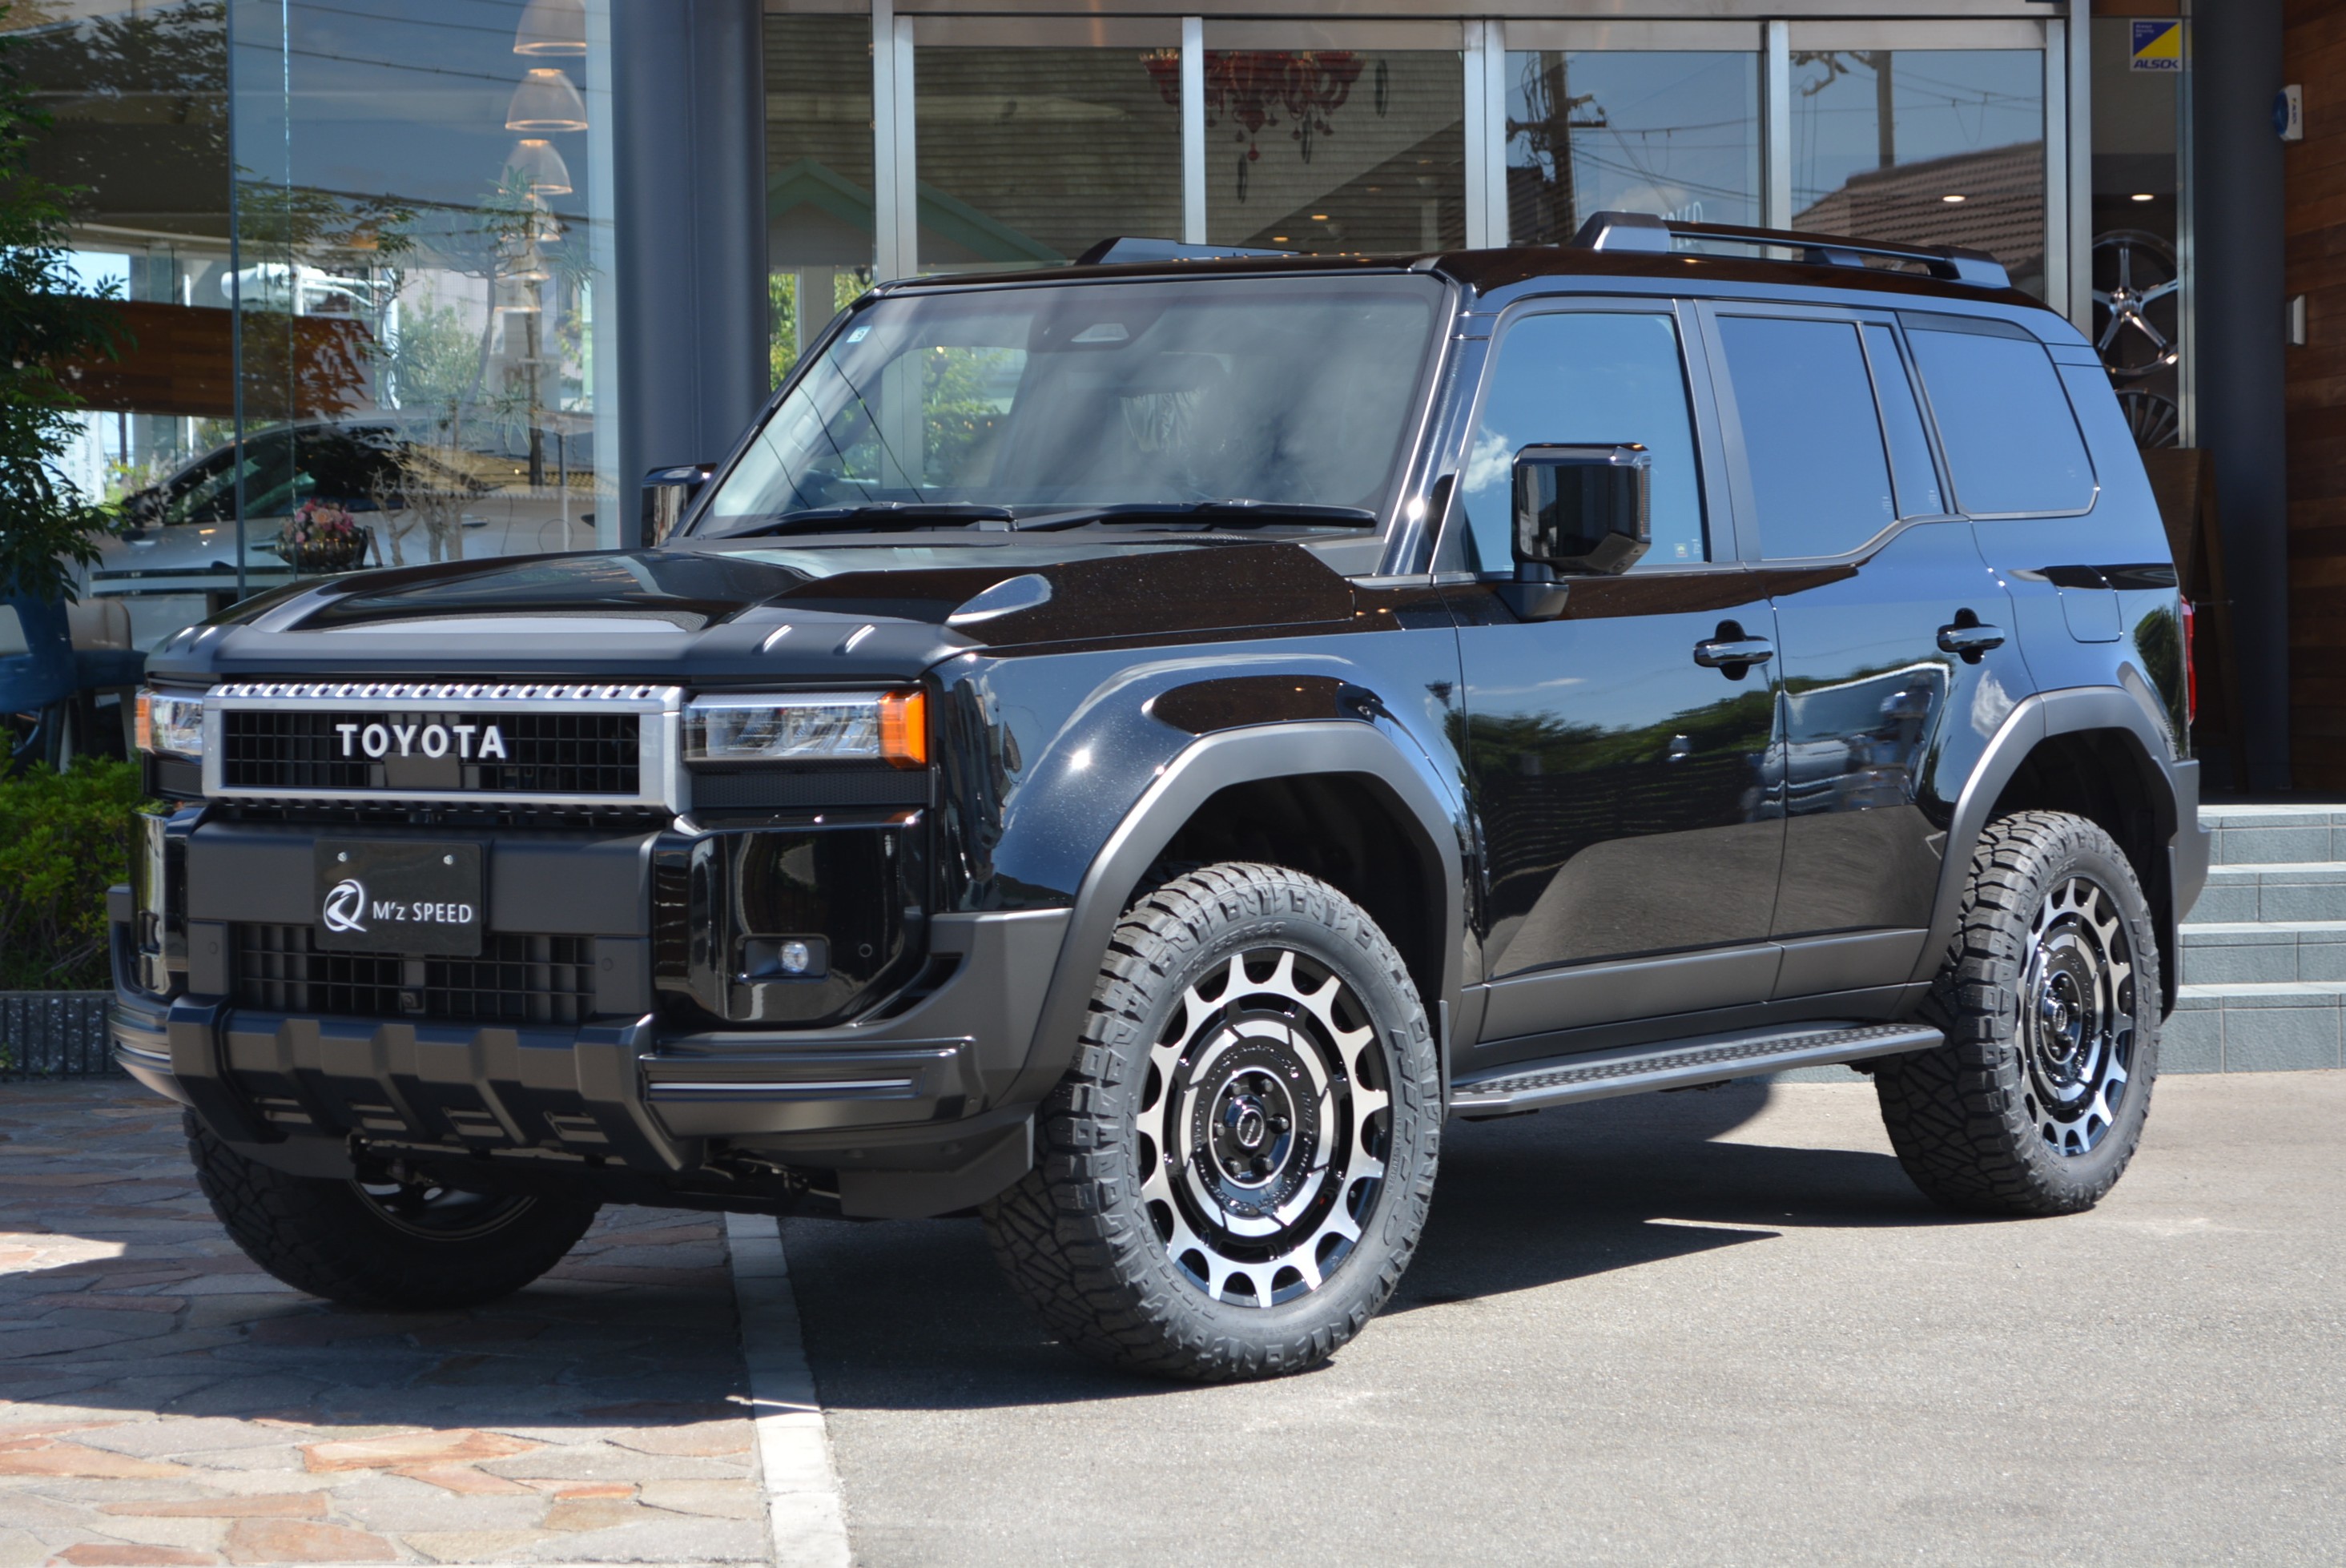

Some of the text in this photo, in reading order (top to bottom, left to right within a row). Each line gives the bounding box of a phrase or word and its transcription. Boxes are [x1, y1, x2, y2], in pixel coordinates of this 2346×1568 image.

[2134, 58, 2179, 70] ALSOK
[336, 723, 506, 758] TOYOTA
[412, 902, 473, 924] SPEED
